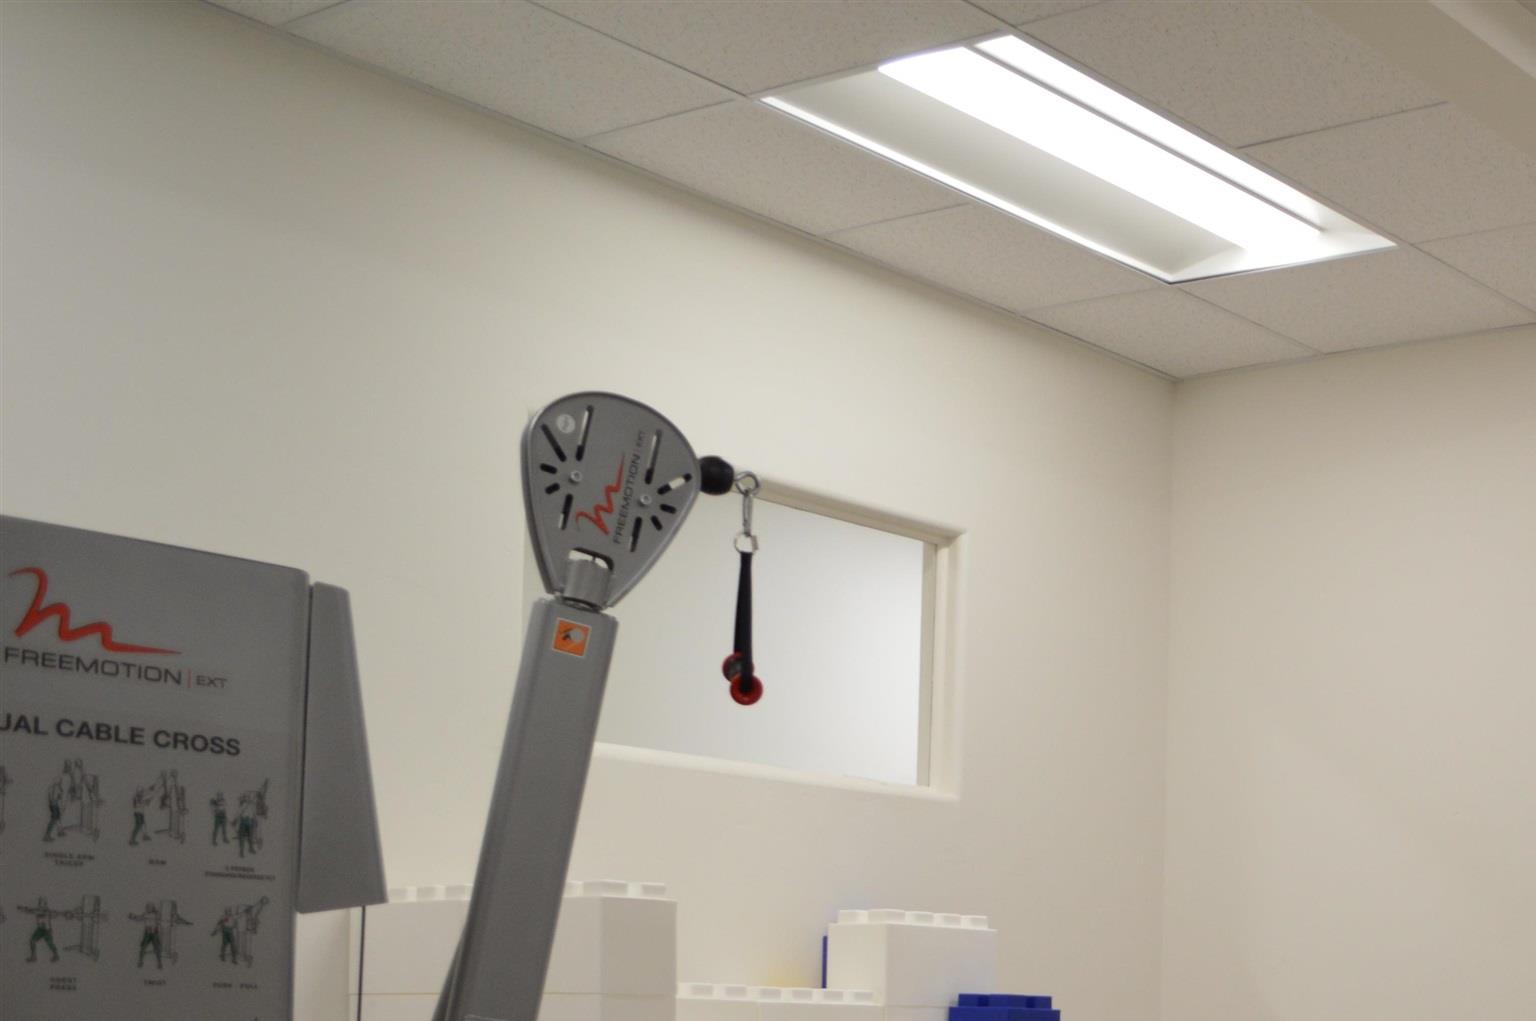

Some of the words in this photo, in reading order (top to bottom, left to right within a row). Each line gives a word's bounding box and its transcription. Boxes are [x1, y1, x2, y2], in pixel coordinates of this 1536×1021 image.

[613, 453, 641, 545] FREEMOTION
[4, 646, 182, 686] FREEMOTION
[196, 674, 228, 690] EXT
[55, 718, 146, 746] CABLE
[153, 729, 242, 756] CROSS
